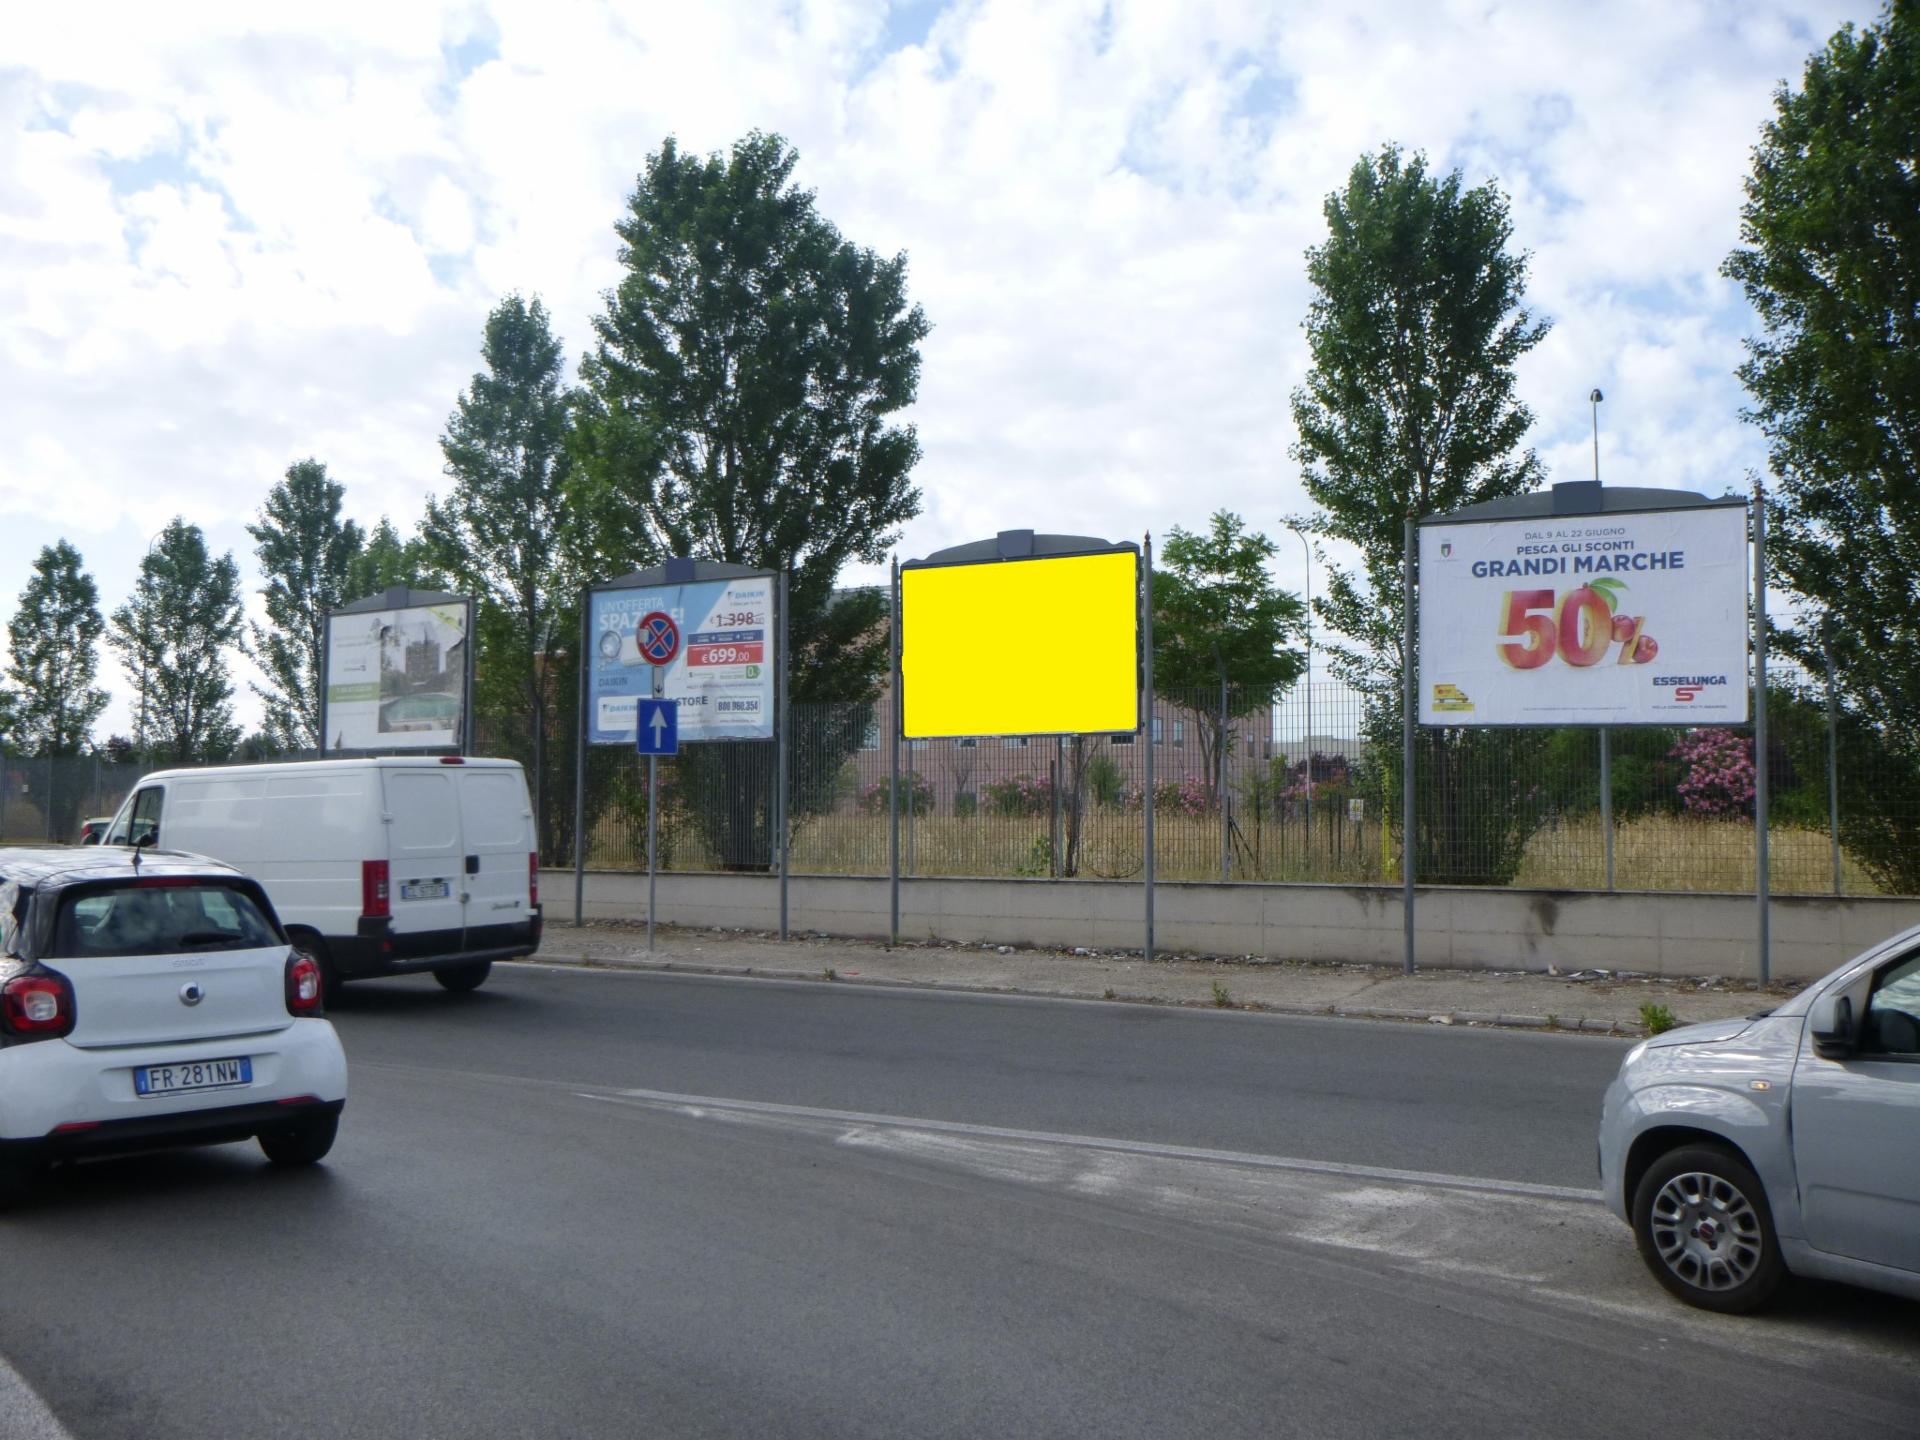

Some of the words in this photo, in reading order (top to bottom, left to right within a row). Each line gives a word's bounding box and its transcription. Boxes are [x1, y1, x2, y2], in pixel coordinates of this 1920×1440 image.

[1525, 532, 1543, 541] DAL
[1546, 531, 1553, 539] 9
[1556, 530, 1569, 539] AL
[1571, 529, 1582, 538] 22
[1585, 527, 1625, 537] GIUGNO
[1516, 544, 1559, 556] PESCA
[1561, 543, 1582, 553] GLI
[1585, 540, 1635, 551] SCONTI
[1471, 557, 1566, 578] GRANDI
[1573, 551, 1685, 574] MARCHE
[600, 597, 664, 612] UN'OFFERTA
[599, 608, 685, 632] SPAZE!
[1496, 585, 1659, 670] 50%
[1652, 675, 1727, 686] ESSELUNGA
[150, 1069, 174, 1090] FR
[181, 1061, 239, 1086] 281NW
